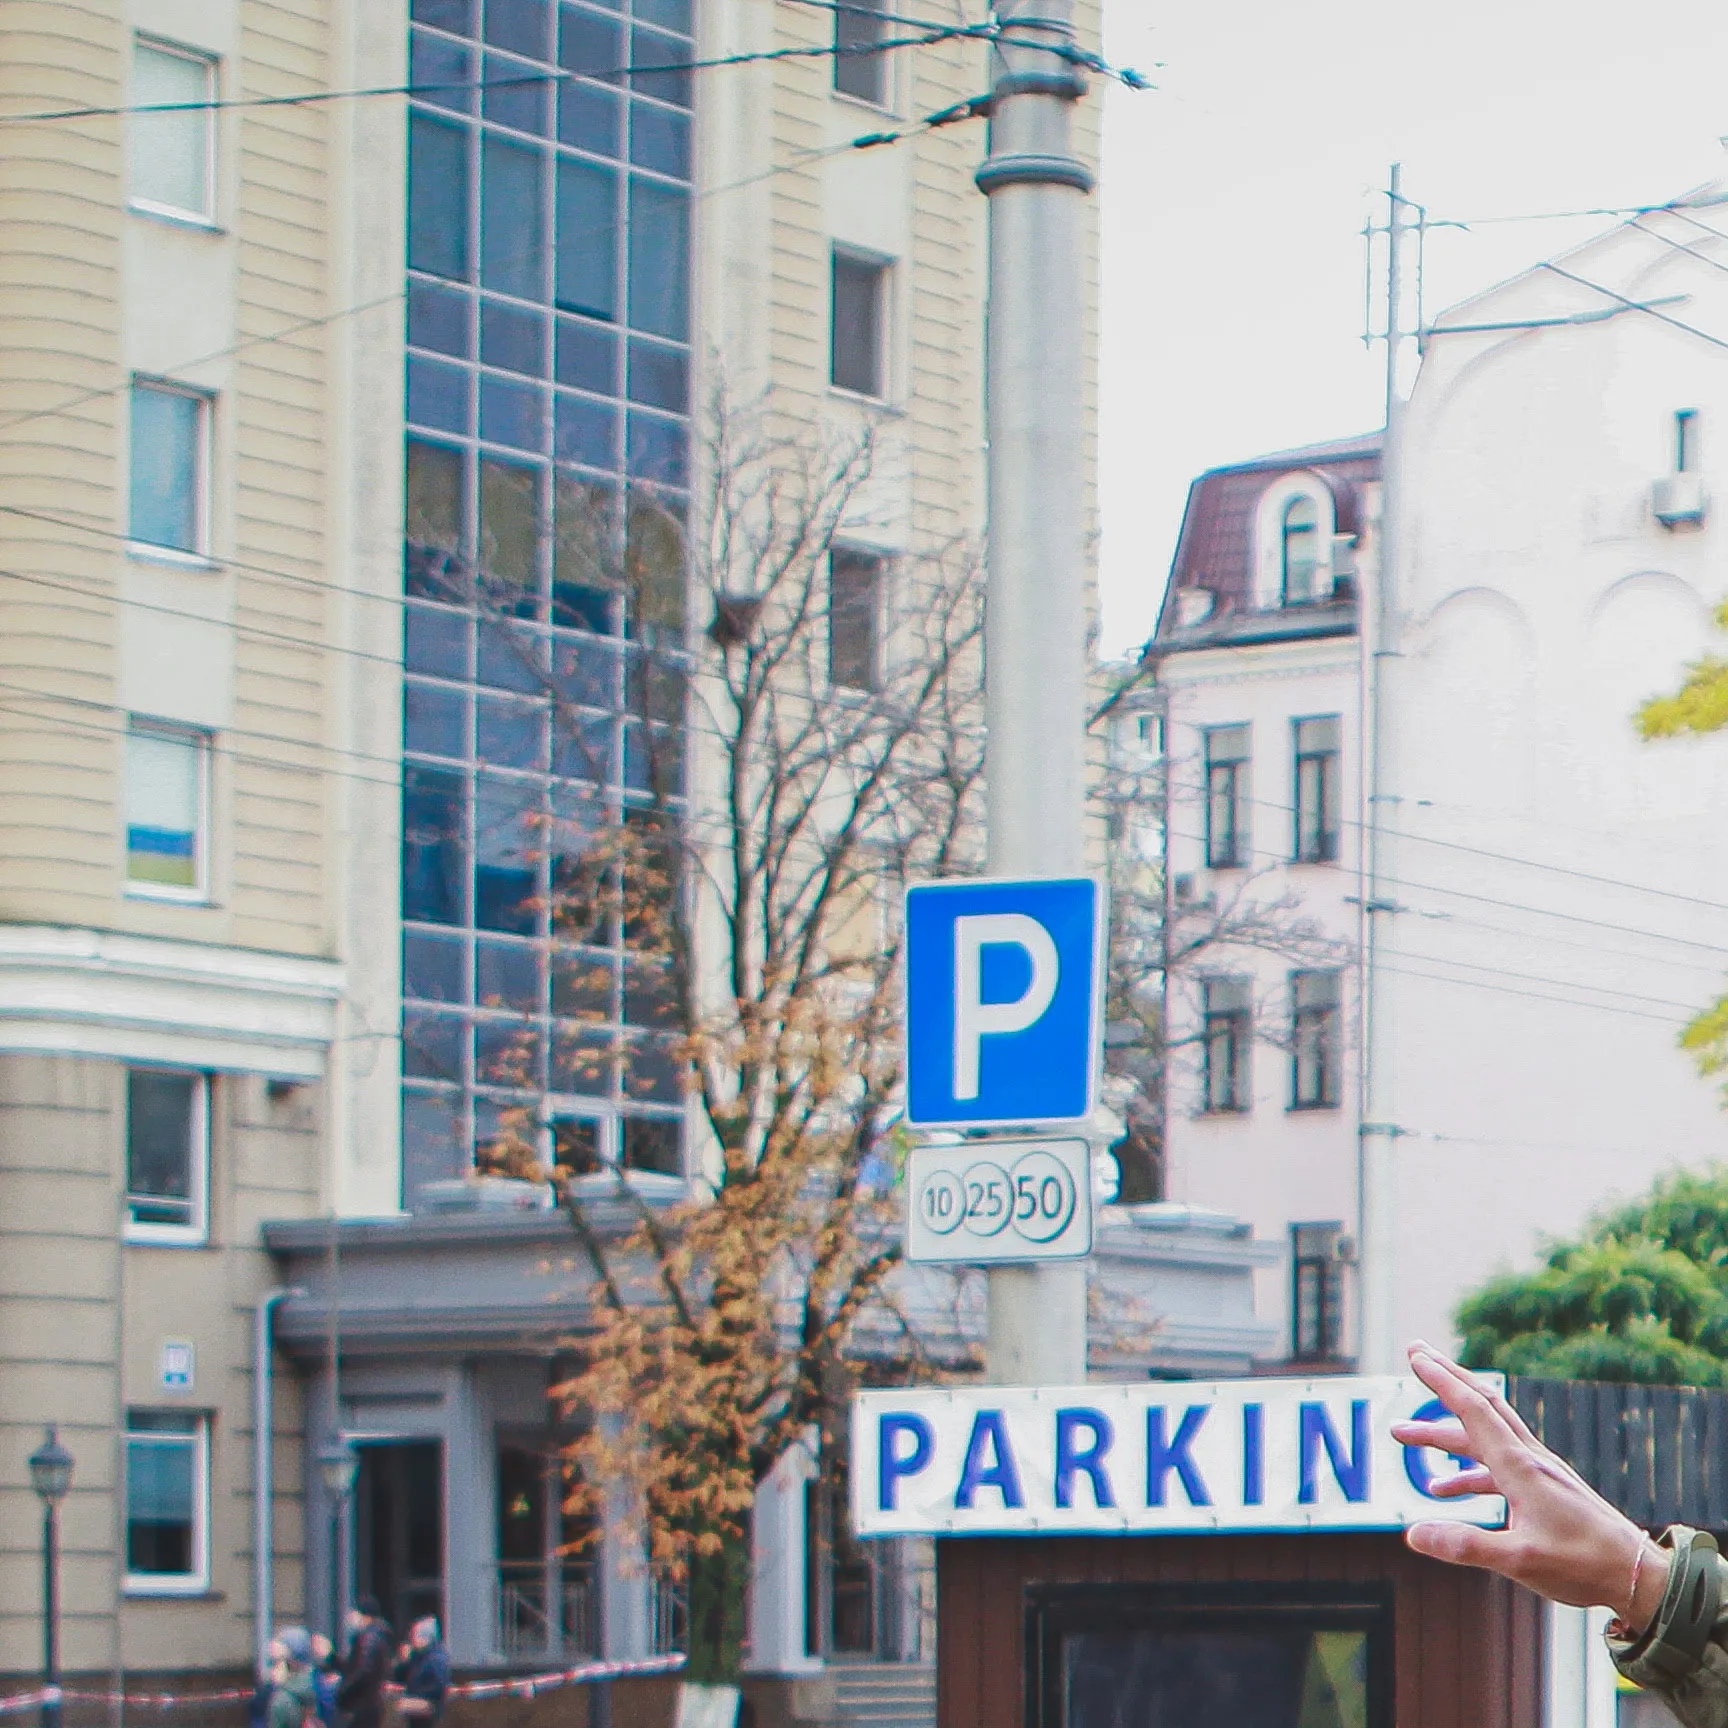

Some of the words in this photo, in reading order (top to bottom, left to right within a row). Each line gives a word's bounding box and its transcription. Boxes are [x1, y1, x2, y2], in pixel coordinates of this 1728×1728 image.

[953, 913, 1060, 1100] P
[925, 1187, 953, 1217] 10
[967, 1182, 1002, 1217] 25
[1016, 1175, 1062, 1220] 50
